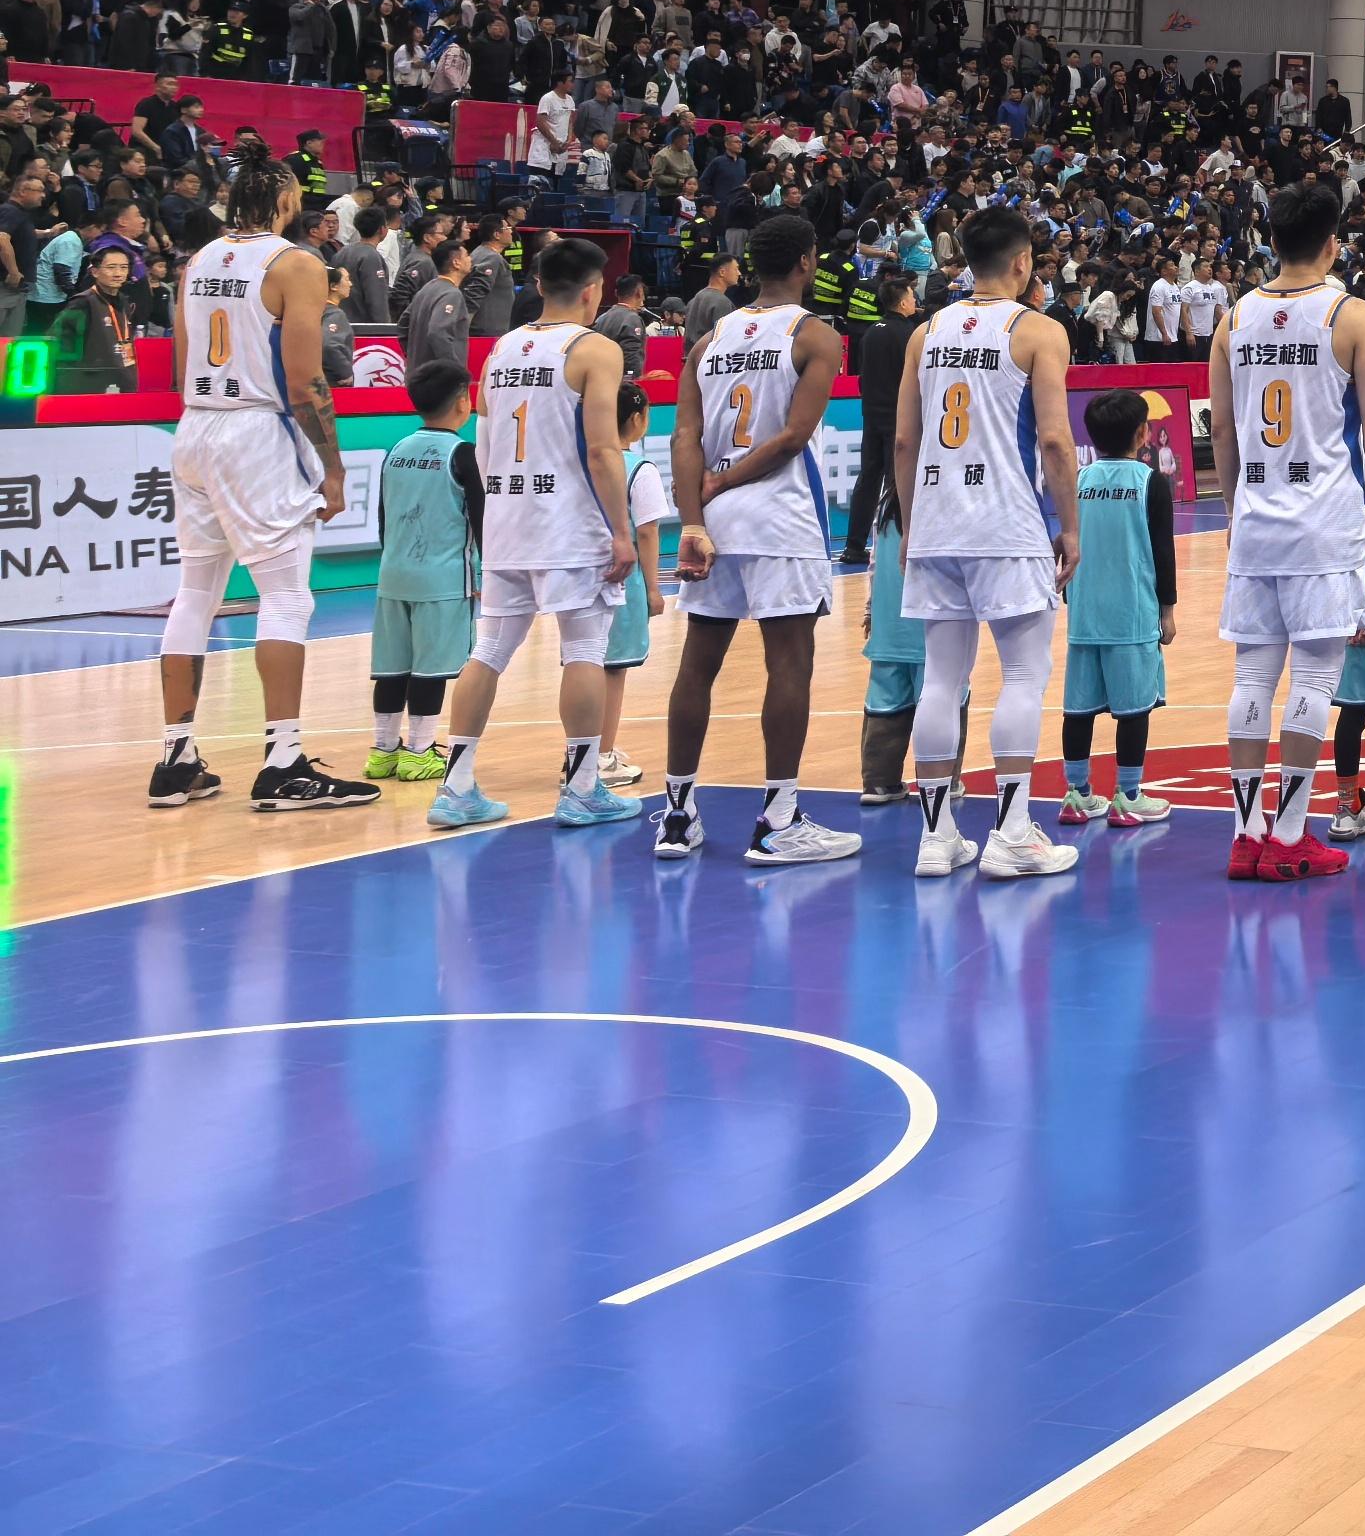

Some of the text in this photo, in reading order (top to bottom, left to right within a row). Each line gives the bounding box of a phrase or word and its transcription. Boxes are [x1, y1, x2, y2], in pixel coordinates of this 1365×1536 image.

[192, 278, 248, 300] 北汽极狐
[208, 308, 232, 368] 0
[10, 340, 49, 393] 0
[705, 349, 782, 376] 北汽极狐
[925, 346, 1001, 372] 北汽极狐
[1237, 343, 1318, 367] 北汽极狐
[490, 367, 553, 390] 北汽极狐
[730, 383, 752, 448] 2
[939, 381, 970, 450] 8
[1262, 378, 1292, 448] 9
[511, 400, 529, 463] 1
[390, 457, 444, 471] 动小雄鹰
[922, 462, 985, 487] 方硕
[1246, 462, 1310, 485] 雷蒙
[486, 473, 555, 496] 陈盈骏
[1078, 488, 1139, 501] 动小雄鹰
[0, 466, 175, 530] 国人寿
[88, 537, 181, 573] LIFE
